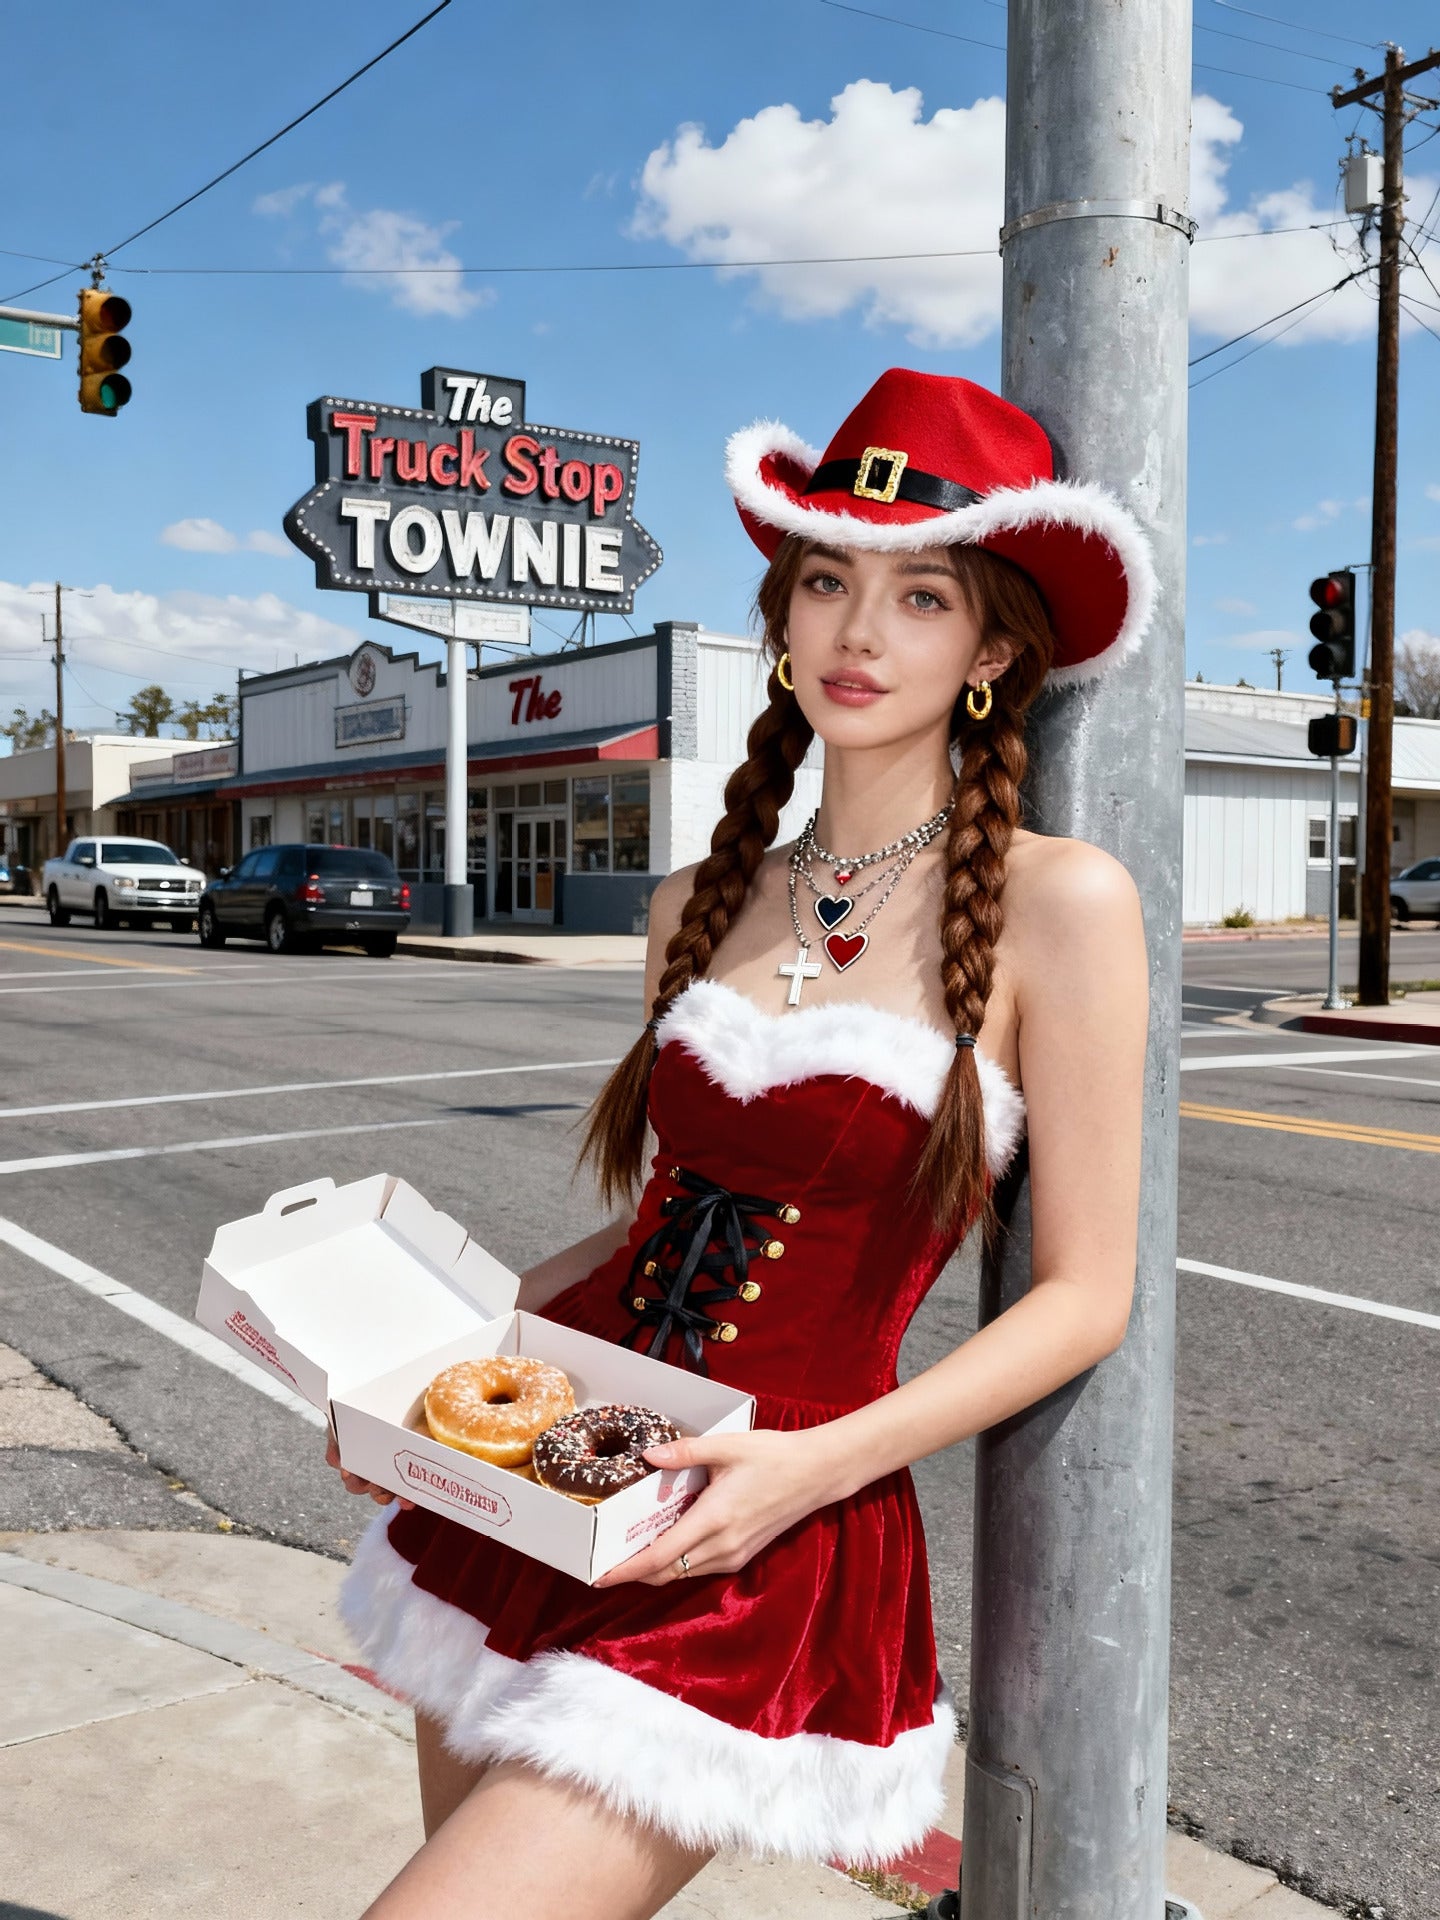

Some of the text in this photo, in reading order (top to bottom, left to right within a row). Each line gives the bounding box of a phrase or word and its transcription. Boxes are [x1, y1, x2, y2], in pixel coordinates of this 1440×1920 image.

[446, 376, 512, 426] The
[332, 412, 624, 517] Truck Stop
[341, 497, 624, 593] TOWNIE
[509, 675, 562, 725] The
